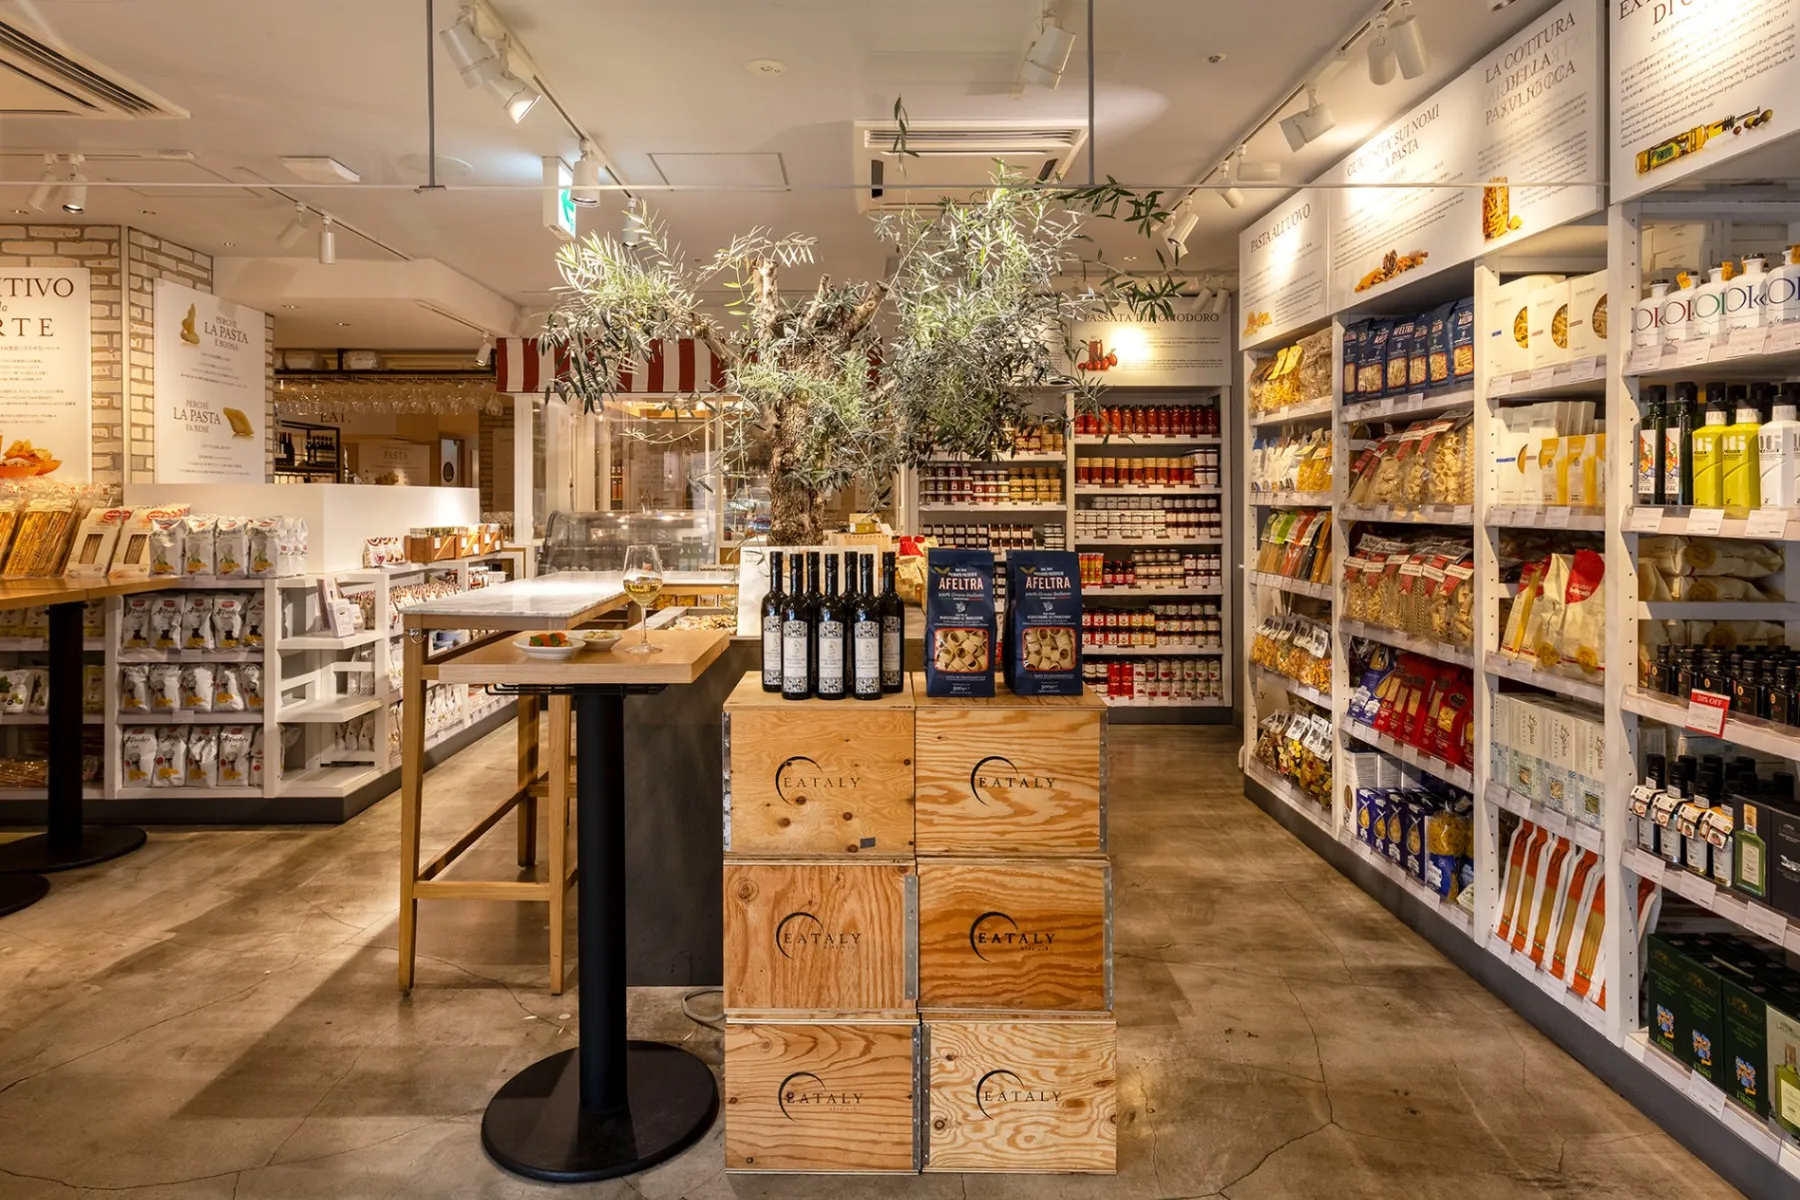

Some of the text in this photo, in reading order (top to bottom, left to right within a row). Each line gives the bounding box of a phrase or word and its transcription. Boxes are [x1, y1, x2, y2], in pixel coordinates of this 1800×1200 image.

[1485, 63, 1502, 84] LA
[1504, 11, 1576, 70] COTTURA
[1411, 103, 1439, 134] NOMI
[0, 277, 74, 298] TIVO
[1084, 313, 1132, 323] PASSATA
[204, 322, 249, 344] LA PASTA
[173, 407, 222, 425] LA PASTA
[939, 576, 984, 590] AFELTRA
[1025, 576, 1071, 589] AFELTRA
[1708, 697, 1723, 706] OFF
[783, 777, 861, 788] EATALY
[979, 777, 1056, 788] EATALY
[784, 932, 861, 944] EATALY
[978, 932, 1056, 944] EATALY
[786, 1092, 864, 1104] EATALY
[984, 1091, 1062, 1102] EATALY
